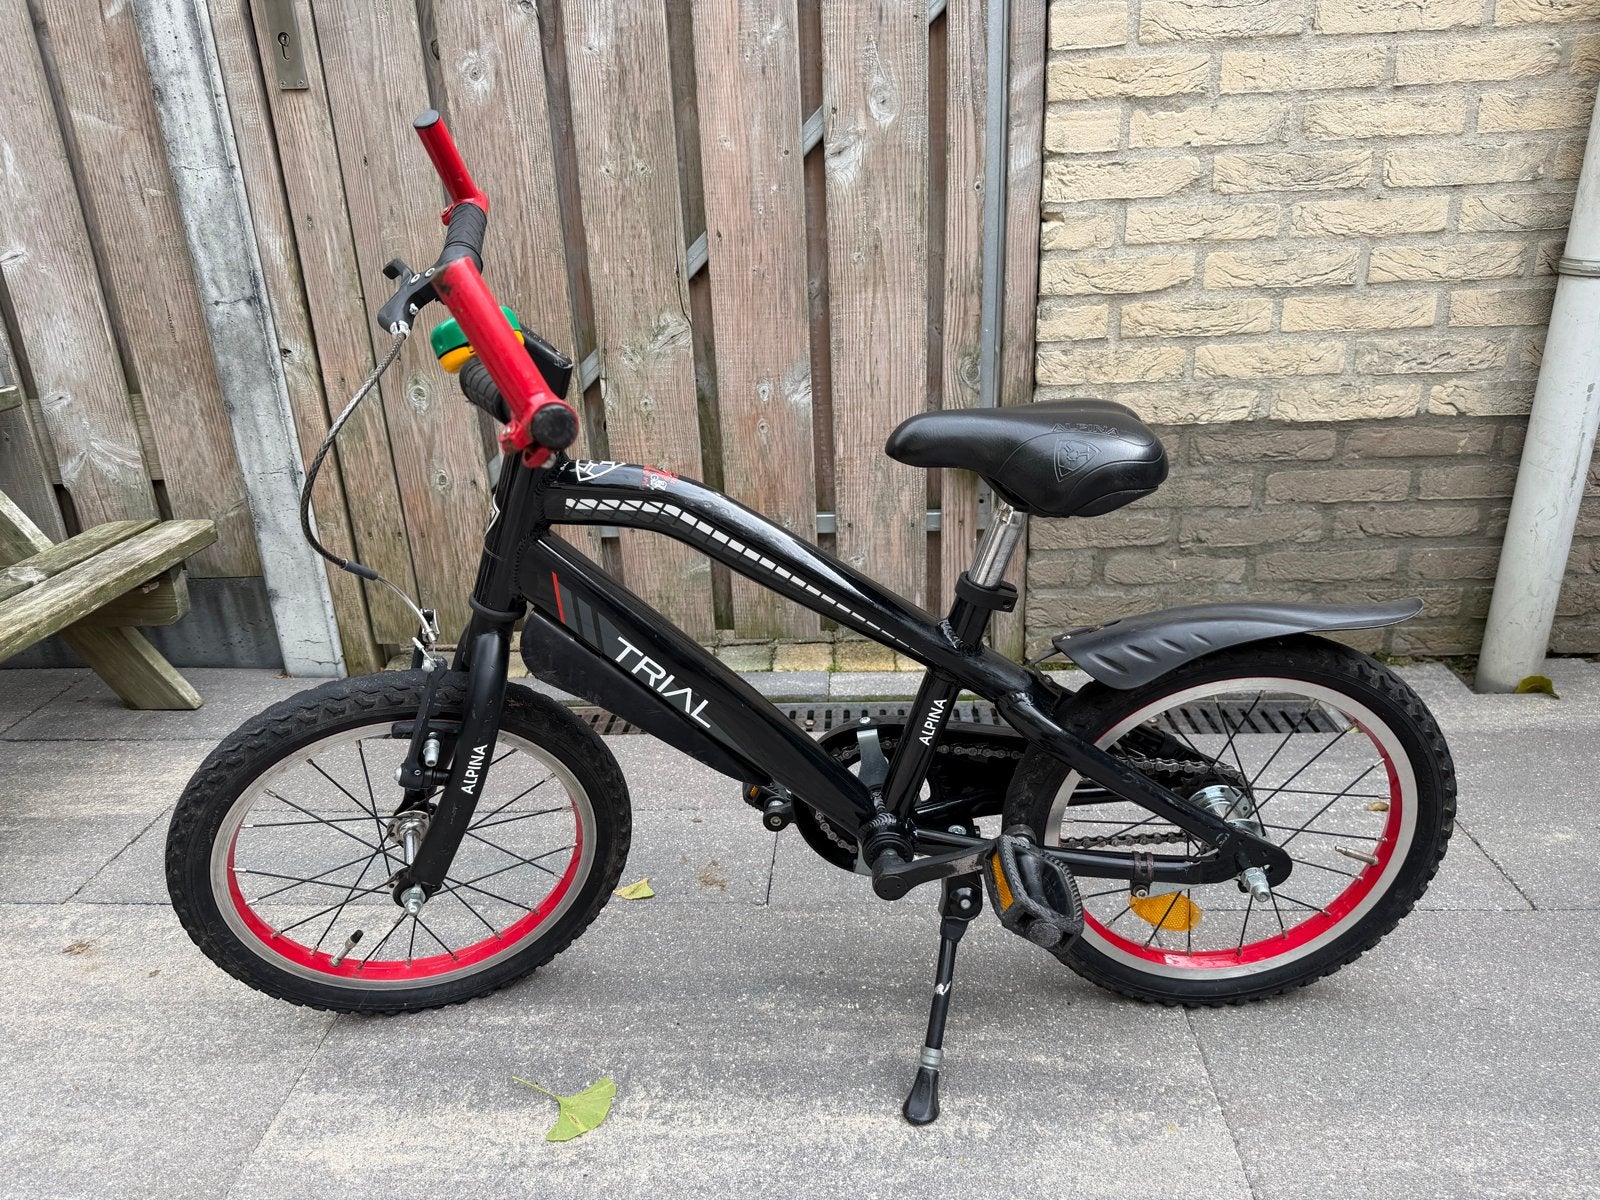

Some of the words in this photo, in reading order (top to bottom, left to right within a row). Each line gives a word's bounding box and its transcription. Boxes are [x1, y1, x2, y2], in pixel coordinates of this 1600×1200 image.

[1051, 422, 1120, 438] ALPINA
[615, 636, 711, 729] TRIAL
[919, 698, 948, 747] ALPINA
[461, 744, 489, 795] ALPINA
